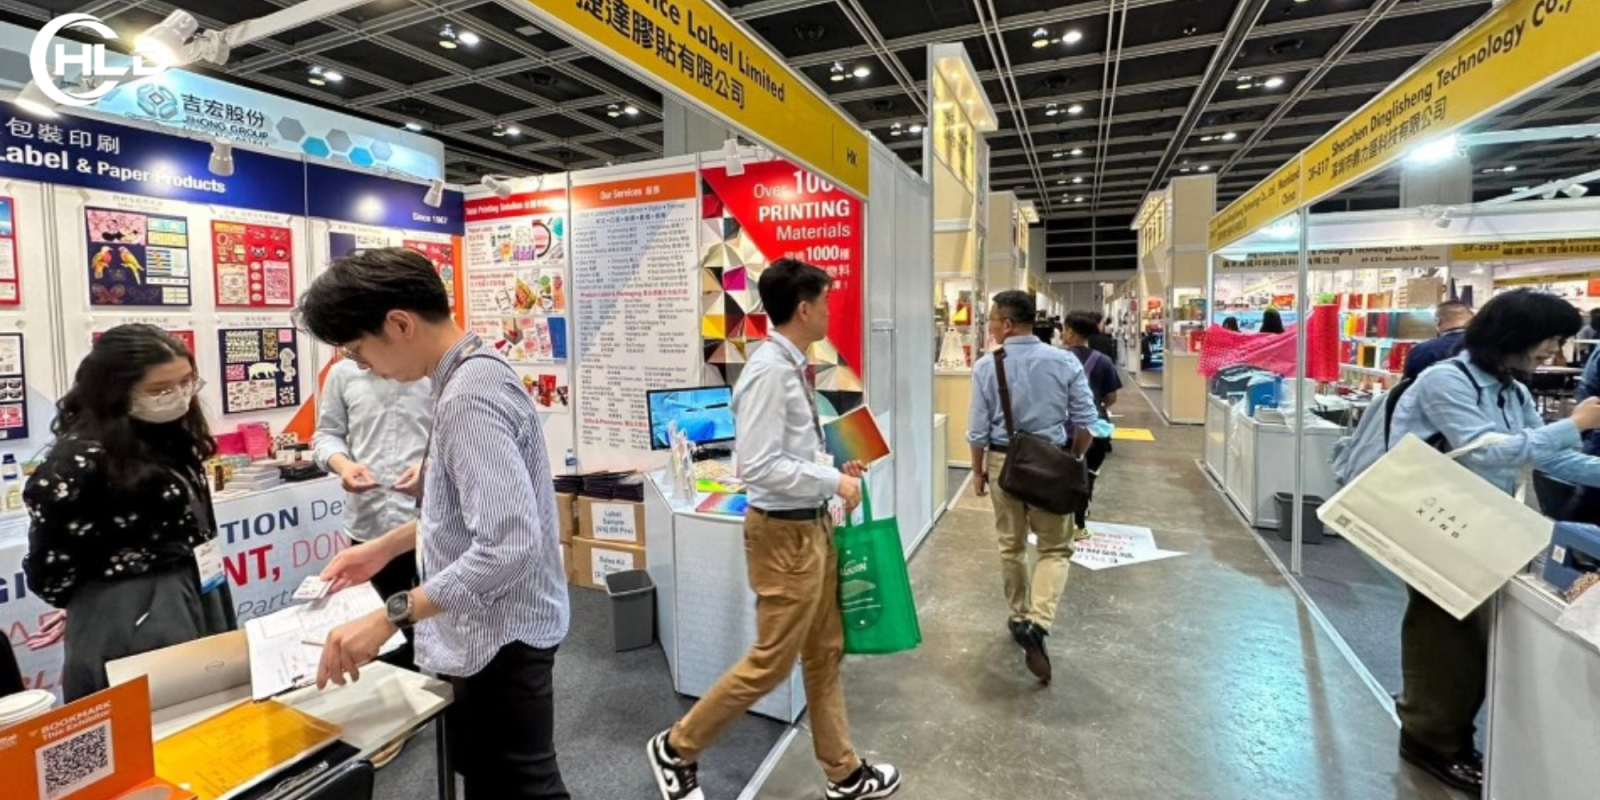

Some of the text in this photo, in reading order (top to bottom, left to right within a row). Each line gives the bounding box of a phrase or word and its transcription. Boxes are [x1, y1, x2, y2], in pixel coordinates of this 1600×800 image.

[687, 9, 733, 65] Label
[738, 51, 785, 102] Limited
[1331, 126, 1369, 157] Shenzhen
[1370, 83, 1433, 132] Dinglisheng
[1436, 20, 1526, 90] Technology
[181, 93, 265, 129] 吉宏股份
[5, 117, 120, 155] 包裝印刷
[230, 125, 269, 139] GROUP
[0, 144, 226, 194] abel & Paper Products
[600, 191, 612, 200] Our
[613, 188, 642, 199] Services
[412, 212, 431, 222] Since
[758, 199, 850, 223] PRINTING
[776, 222, 850, 241] Materials
[311, 498, 347, 522] De
[1415, 507, 1460, 539] XING
[1437, 506, 1468, 530] TAI
[236, 588, 296, 620] Part
[41, 700, 111, 734] BOOKMARK
[42, 709, 111, 741] This Exhibitor
